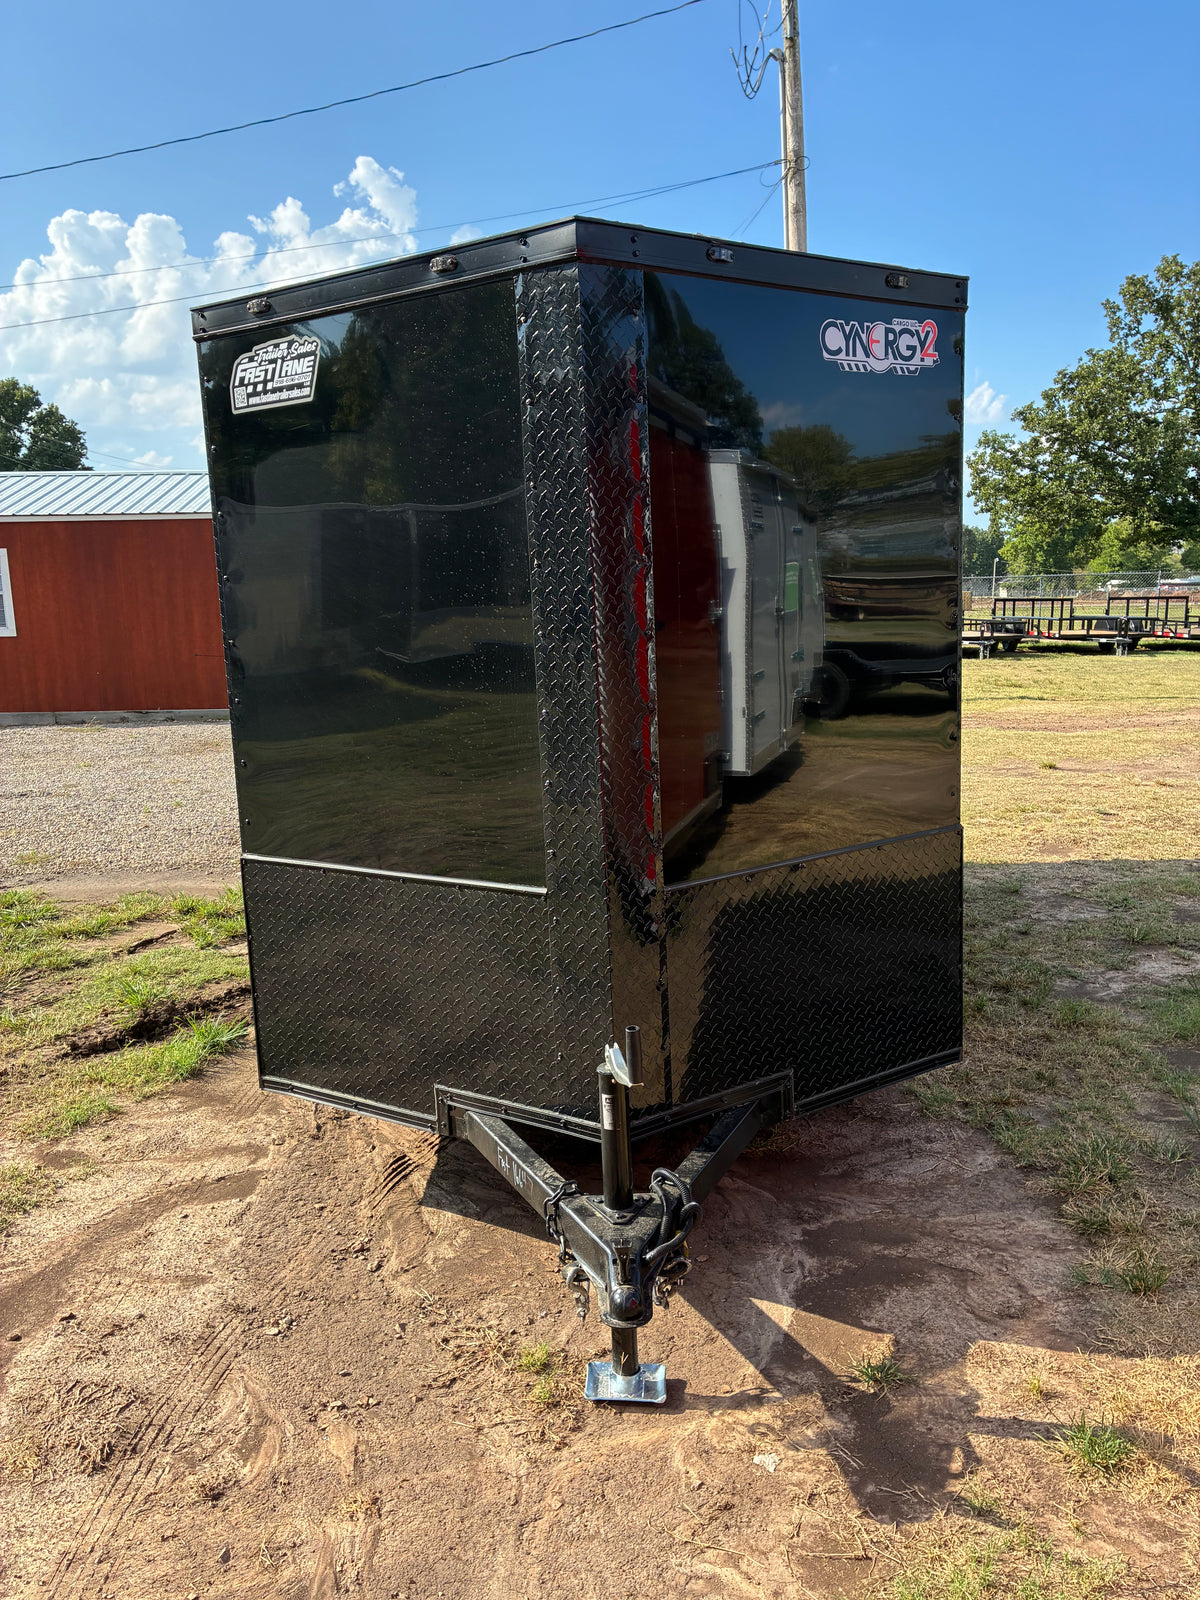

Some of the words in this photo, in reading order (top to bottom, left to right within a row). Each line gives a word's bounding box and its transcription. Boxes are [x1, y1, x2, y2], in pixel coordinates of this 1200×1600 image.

[892, 319, 910, 328] CARGO
[255, 346, 289, 364] Trailer
[290, 341, 318, 357] Sales
